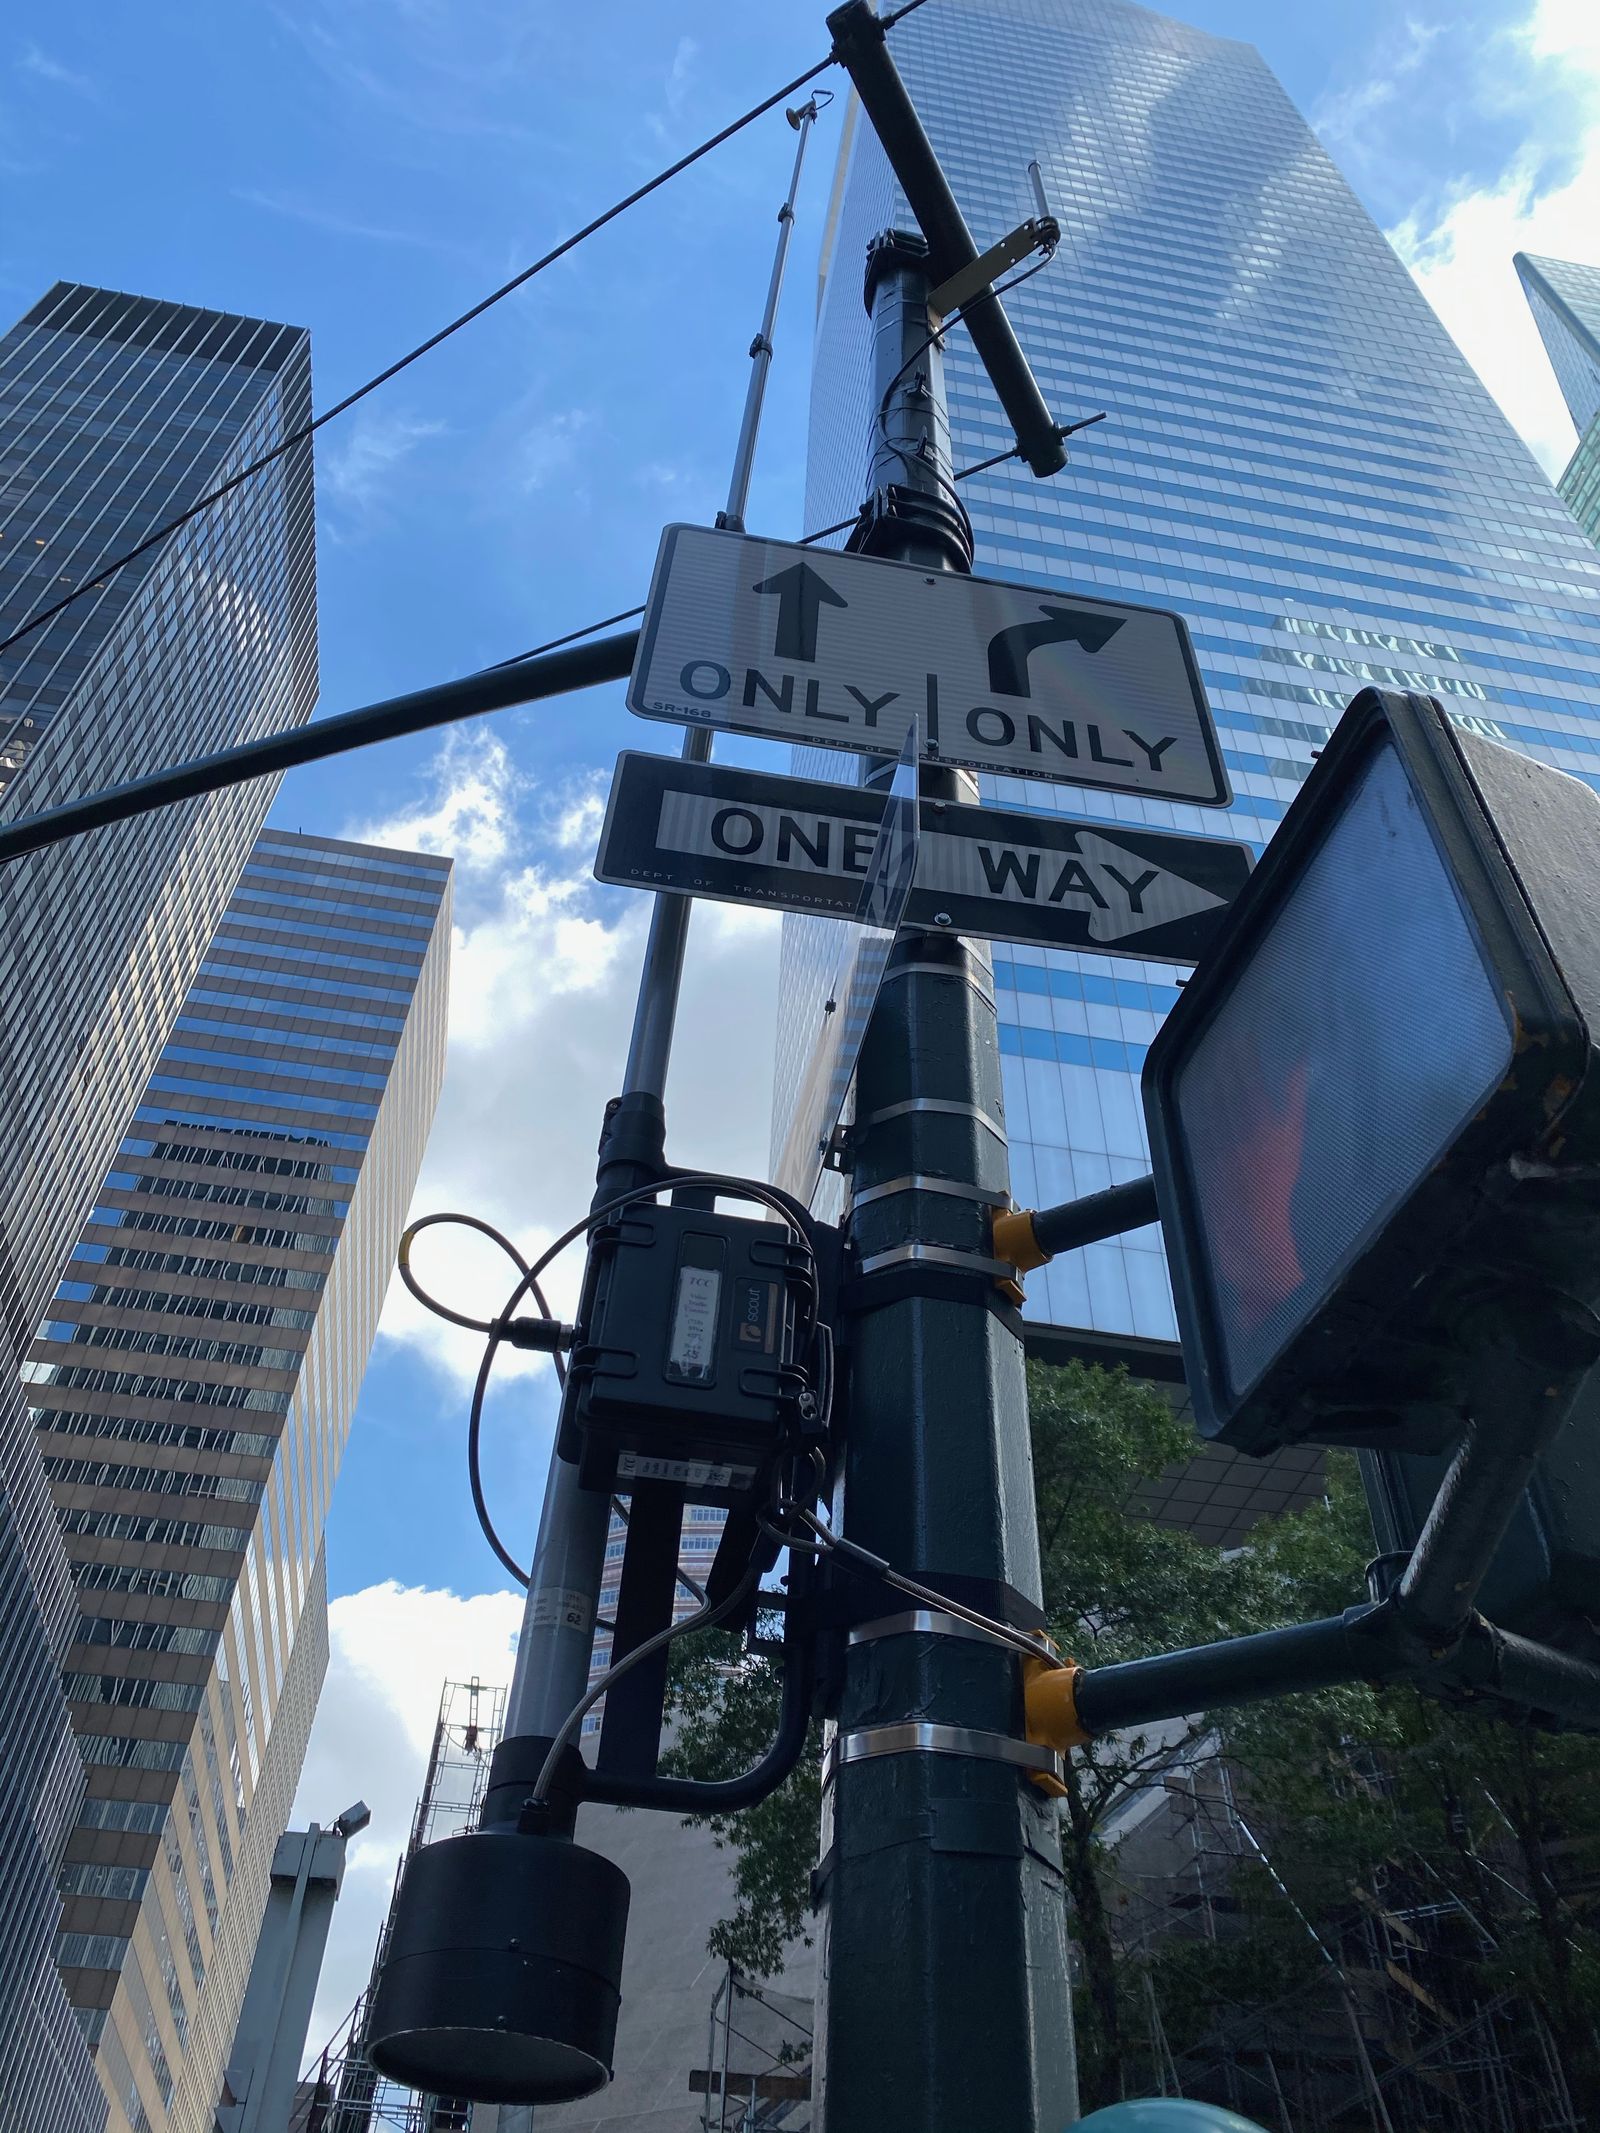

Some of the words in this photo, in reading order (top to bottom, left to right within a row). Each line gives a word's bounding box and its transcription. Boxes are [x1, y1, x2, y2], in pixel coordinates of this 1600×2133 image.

[652, 701, 711, 718] SR-168
[678, 658, 901, 728] ONLY
[811, 736, 855, 750] DEPT
[864, 744, 883, 754] OF
[897, 749, 1055, 780] TANSPORTATION
[965, 706, 1178, 773] ONLY
[709, 807, 880, 874] ONE
[977, 845, 1160, 915] WAY
[629, 867, 674, 882] DEPT
[693, 877, 715, 887] OF
[733, 884, 854, 909] TRANSPORTAT
[747, 1287, 761, 1322] scout
